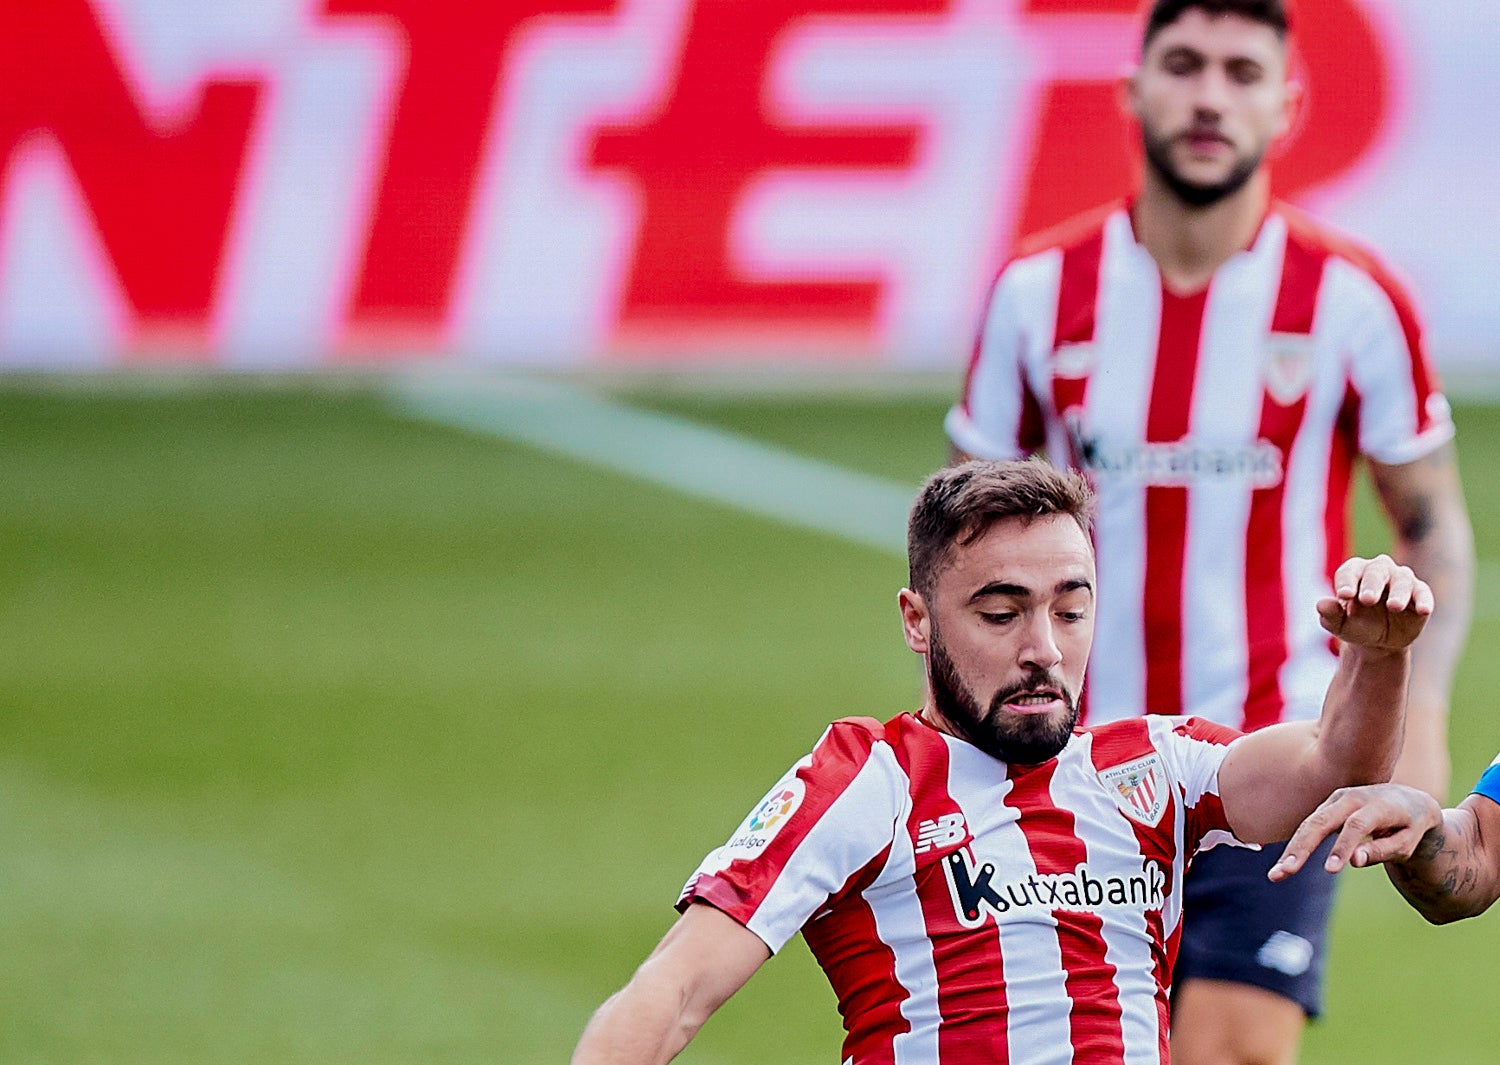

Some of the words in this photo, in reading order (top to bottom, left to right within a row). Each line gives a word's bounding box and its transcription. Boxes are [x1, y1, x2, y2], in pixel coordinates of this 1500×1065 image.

[1105, 764, 1138, 779] ATHLETIC
[1137, 758, 1156, 770] CLUB
[1134, 802, 1160, 821] BILBAO
[948, 852, 1162, 921] Kutxabank
